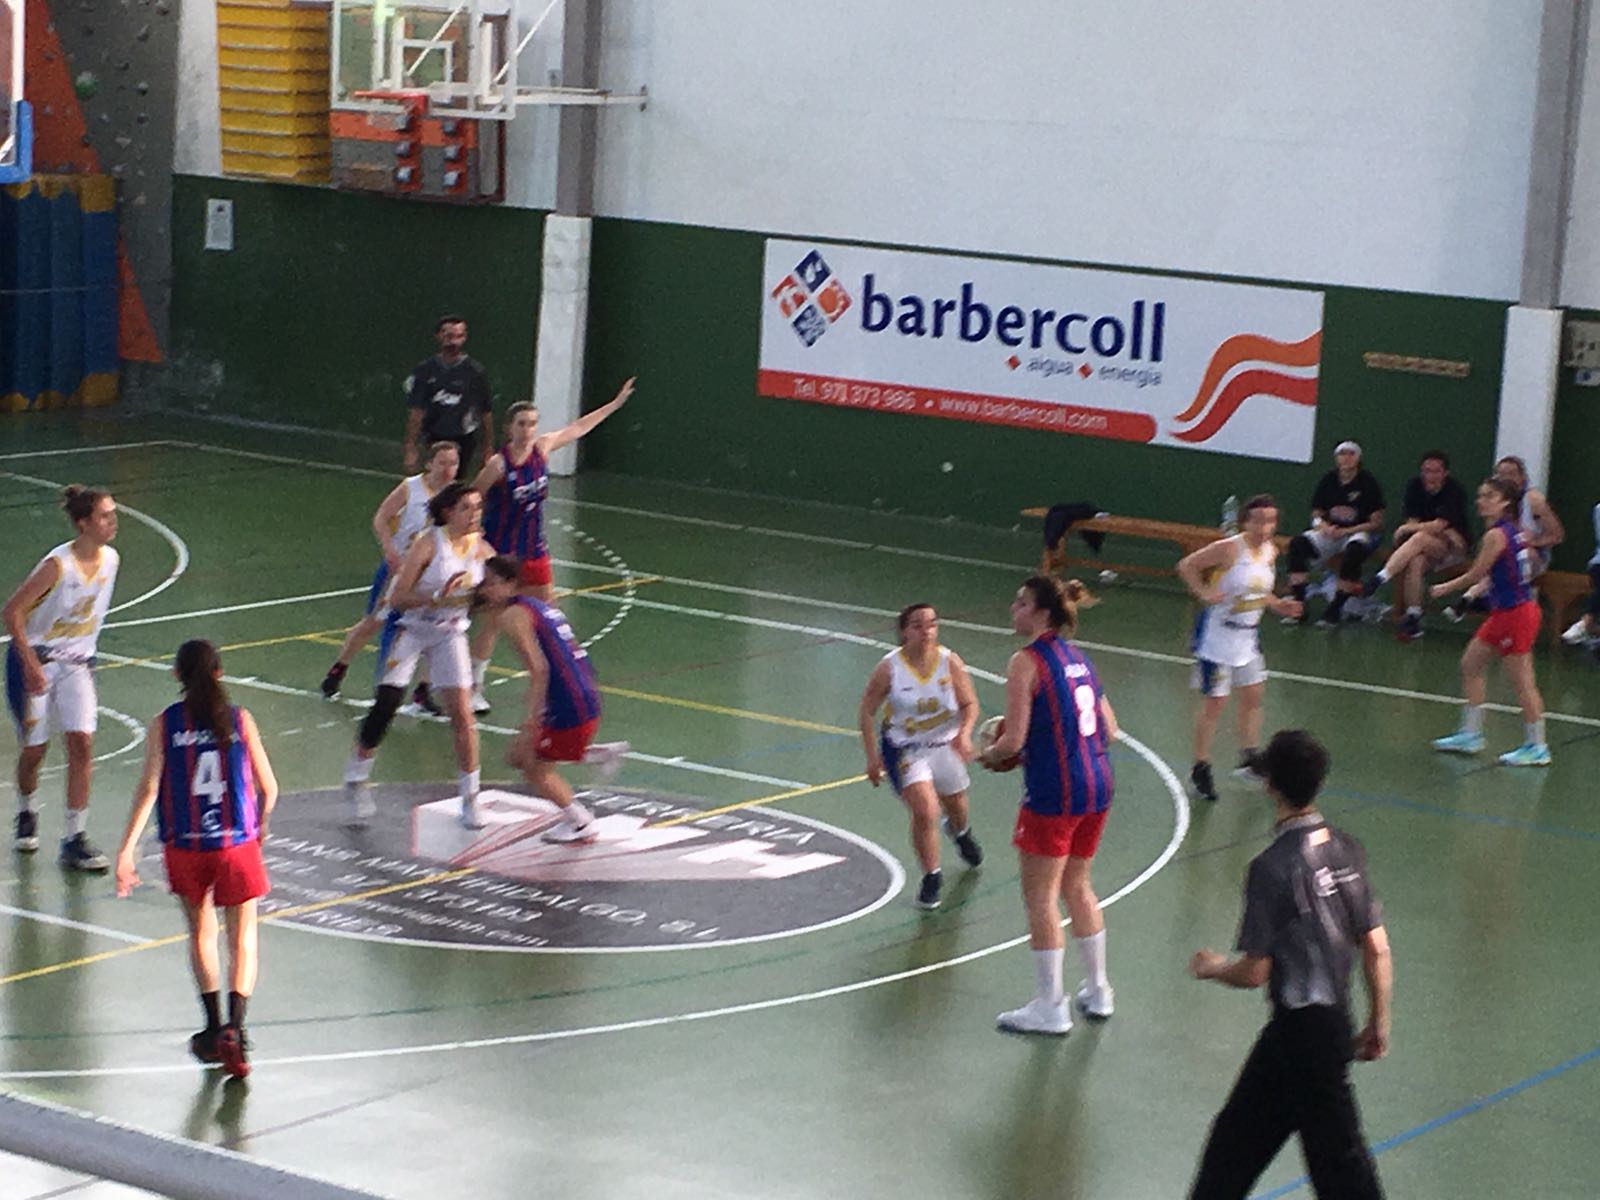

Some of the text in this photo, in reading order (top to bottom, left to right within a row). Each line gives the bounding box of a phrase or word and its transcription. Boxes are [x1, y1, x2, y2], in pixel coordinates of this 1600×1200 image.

[861, 273, 1166, 363] barbercoll
[1026, 354, 1163, 388] aigua energia
[191, 749, 228, 806] 4
